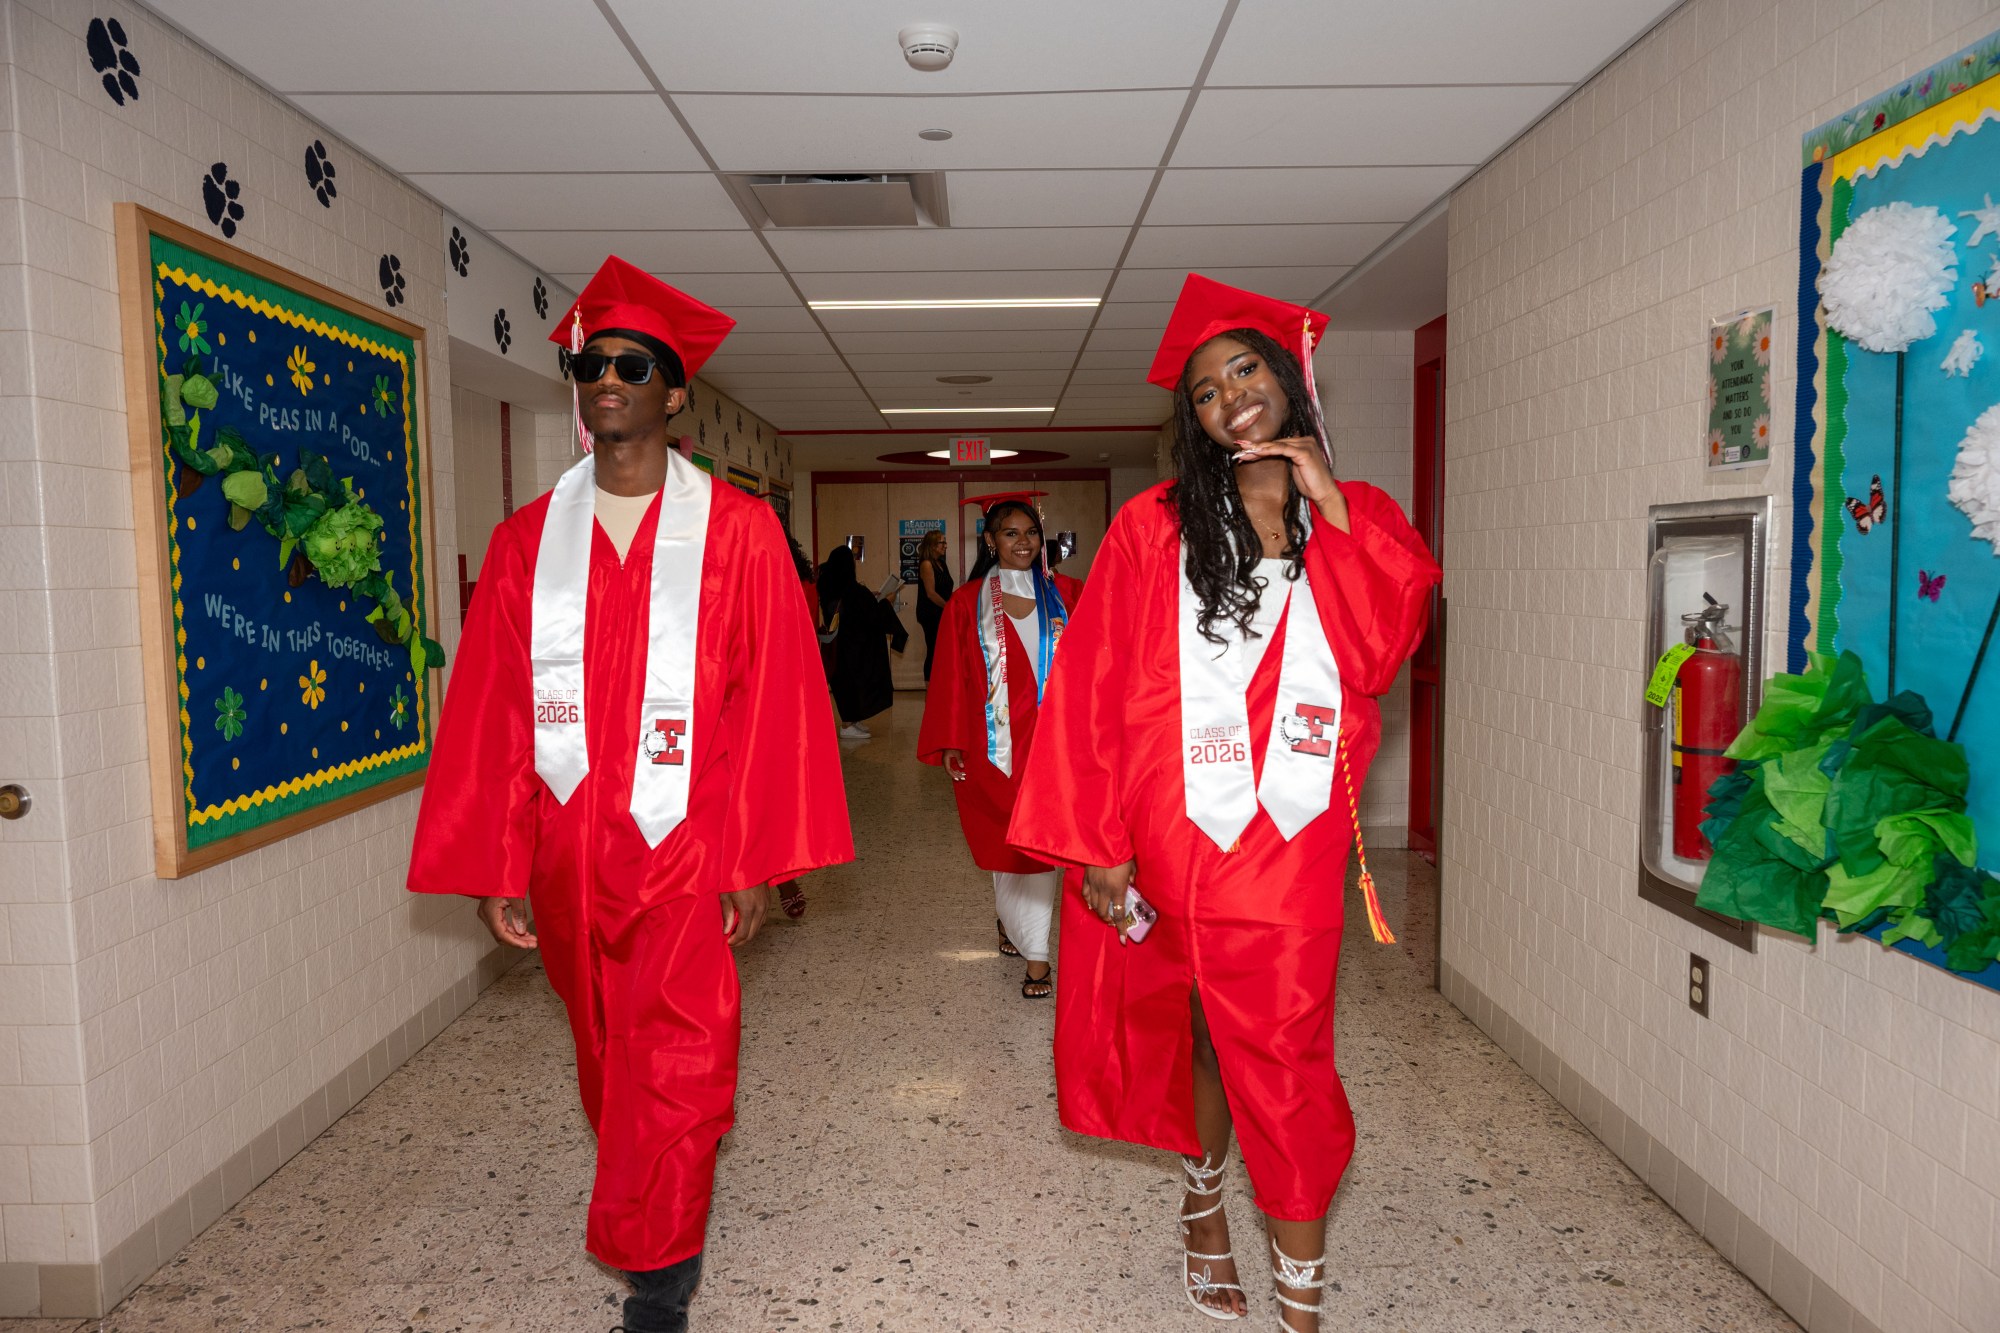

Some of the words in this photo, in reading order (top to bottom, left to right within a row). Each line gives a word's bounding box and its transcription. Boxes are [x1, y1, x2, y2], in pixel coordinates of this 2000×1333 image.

[1730, 359, 1744, 372] YOUR
[1722, 374, 1753, 389] ATTENDANCE
[1725, 391, 1749, 405] MATTERS
[1723, 409, 1733, 420] AND
[1734, 408, 1742, 419] SO
[1743, 406, 1752, 417] DO
[259, 402, 300, 432] PEAS
[305, 409, 322, 432] IN
[328, 411, 338, 433] A
[342, 424, 381, 467] POD...
[1730, 424, 1742, 435] YOU
[957, 440, 985, 461] EXIT
[204, 593, 256, 644] WE'RE
[262, 624, 280, 652] IN
[286, 621, 321, 652] THIS
[326, 632, 394, 671] TOGETHER.
[537, 689, 563, 700] CLASS
[566, 689, 578, 700] OF
[1647, 691, 1664, 703] 2025
[537, 705, 579, 723] 2026
[1190, 727, 1226, 739] CLASS
[1229, 725, 1243, 737] OF
[1190, 742, 1246, 764] 2026
